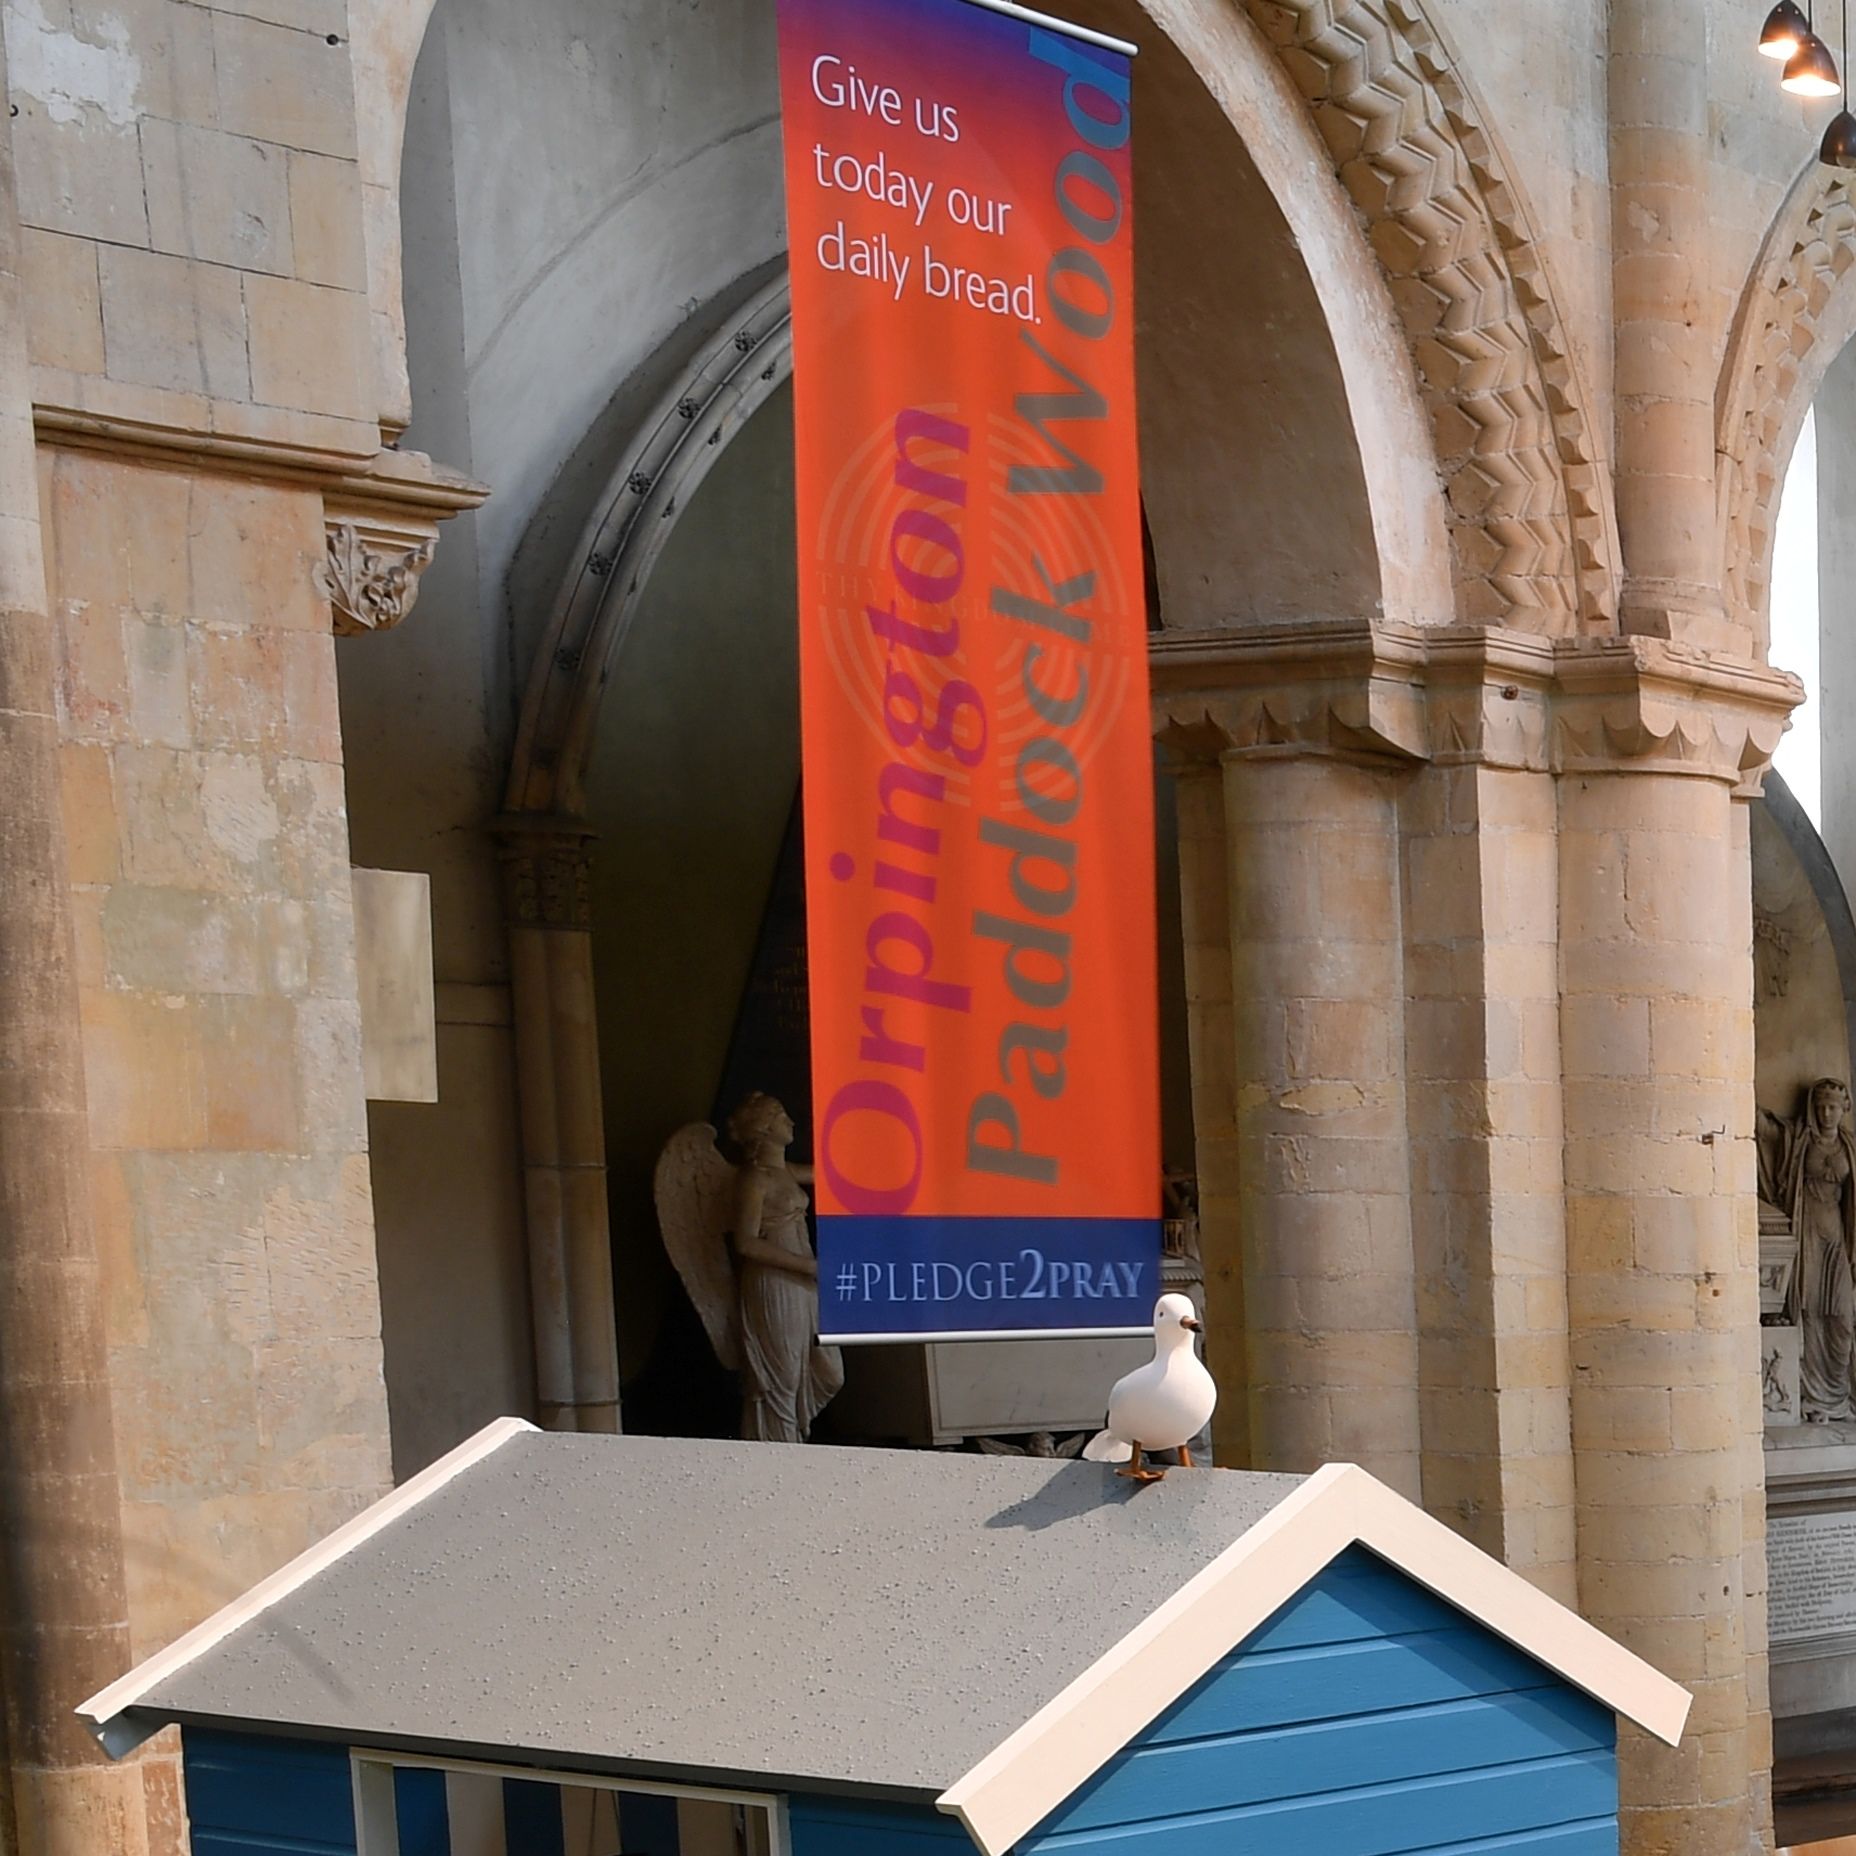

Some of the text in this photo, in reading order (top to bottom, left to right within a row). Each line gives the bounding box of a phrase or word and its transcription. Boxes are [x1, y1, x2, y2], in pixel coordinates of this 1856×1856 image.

[811, 54, 960, 143] Give us
[812, 142, 1013, 236] today our
[816, 220, 1042, 325] daily bread.
[1007, 25, 1131, 497] Wood
[820, 407, 988, 1216] Orpington
[965, 548, 1100, 1186] Paddock
[835, 1246, 1145, 1303] #PLEDGE2PRAY
